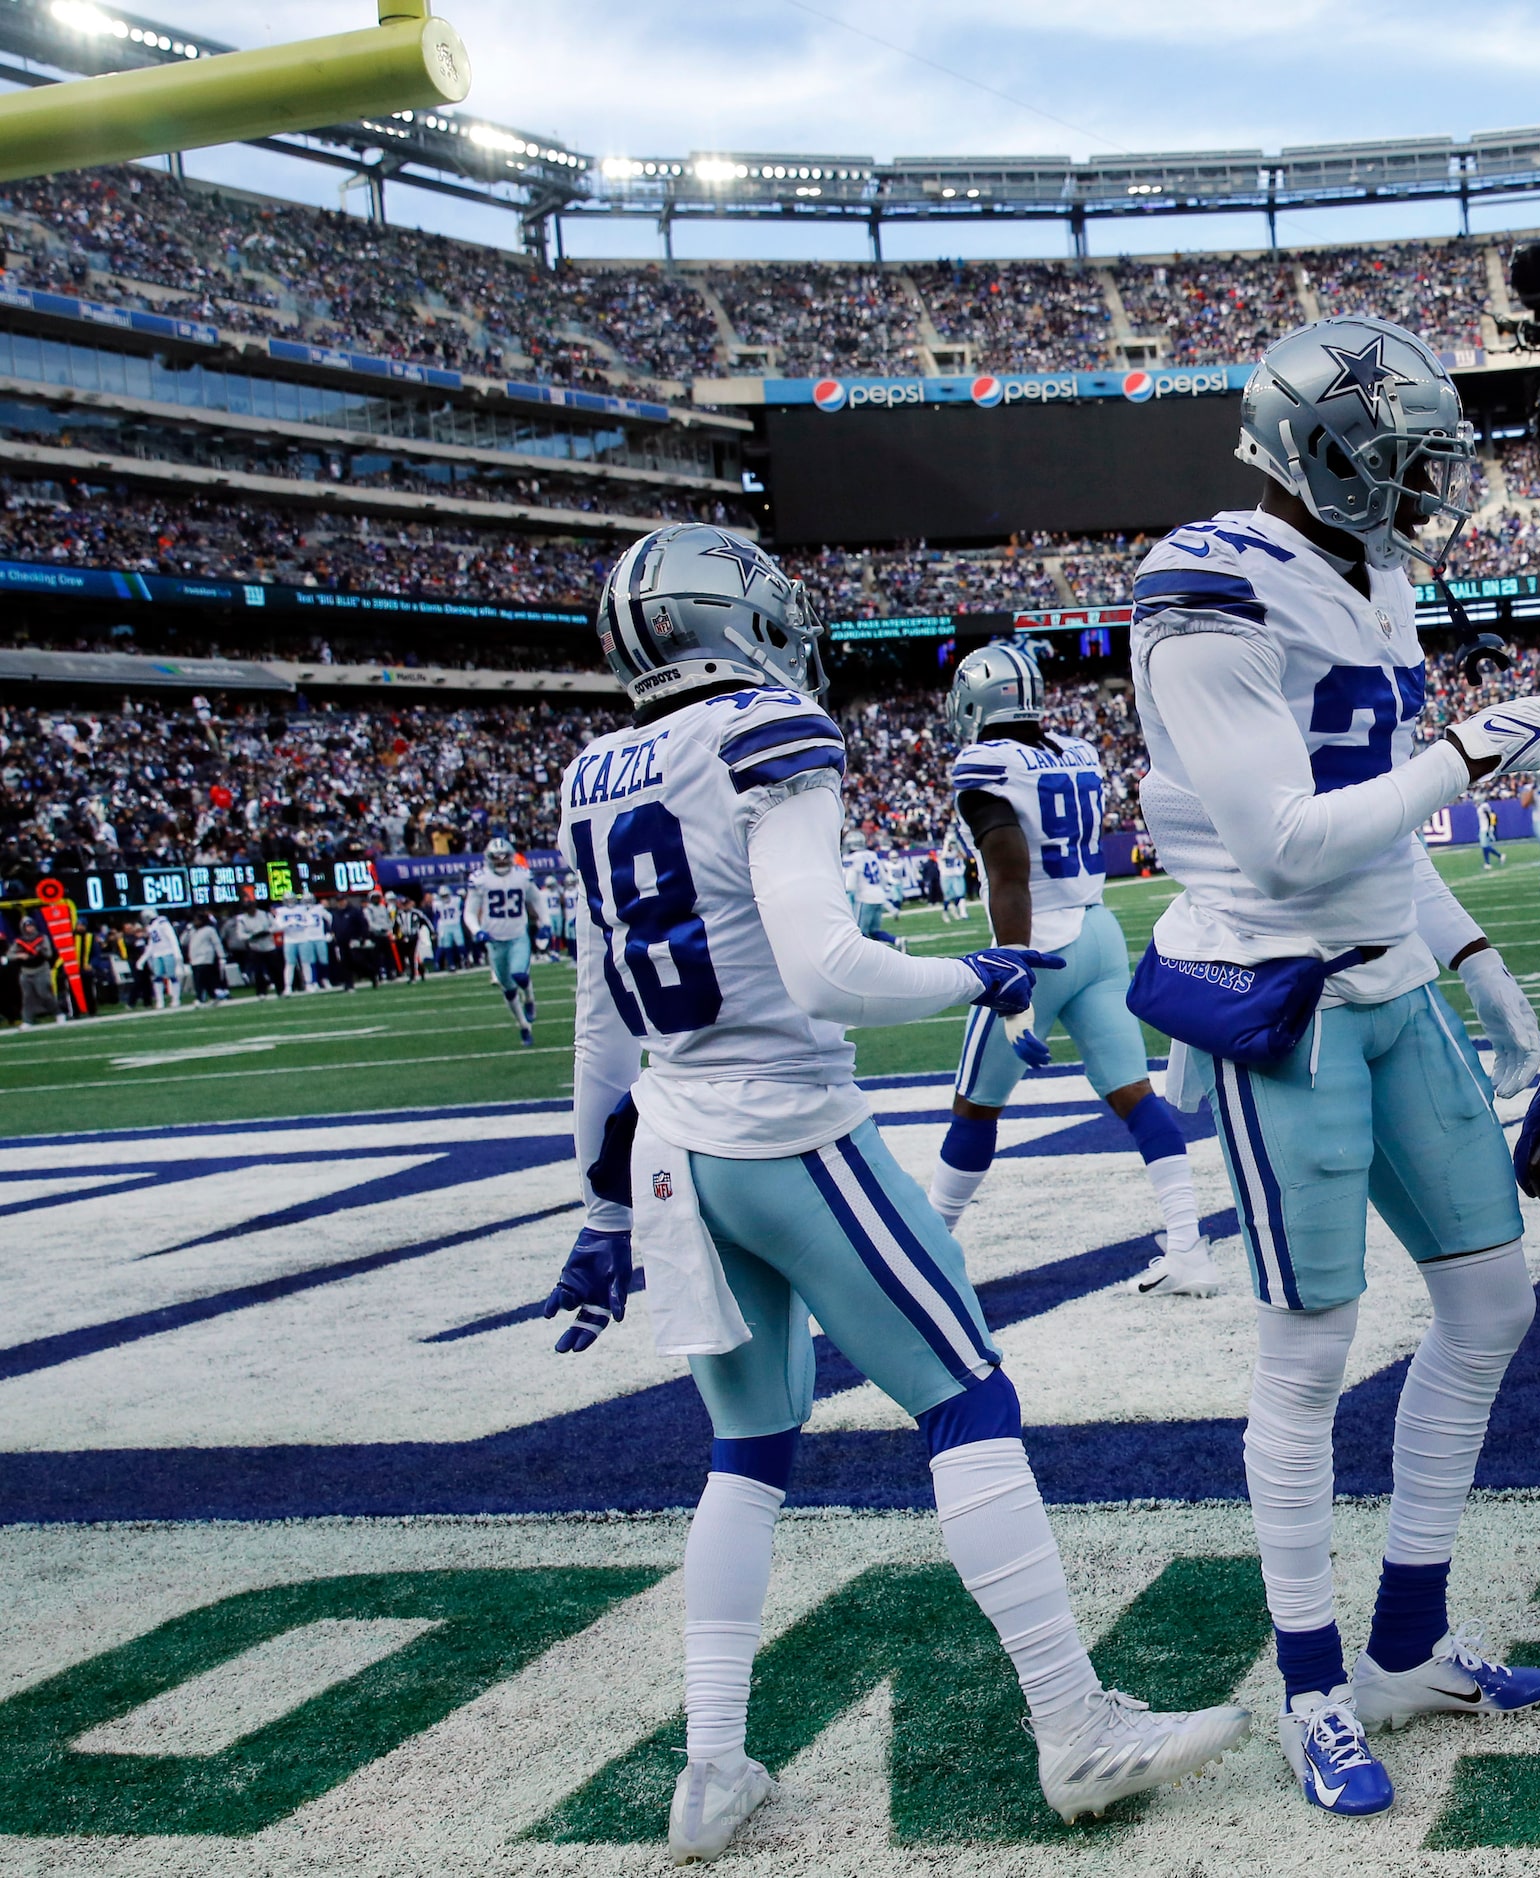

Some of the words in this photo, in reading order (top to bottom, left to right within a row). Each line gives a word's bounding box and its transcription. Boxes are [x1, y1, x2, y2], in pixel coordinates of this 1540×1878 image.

[848, 380, 925, 408] pepsi
[1004, 376, 1078, 403] pepsi
[1155, 368, 1228, 397] pepsi
[634, 668, 681, 695] COWBOYS
[570, 730, 670, 808] KAZEE
[1037, 771, 1106, 879] 90
[142, 875, 184, 904] 6:40
[272, 869, 292, 893] 25
[488, 889, 523, 918] 23
[571, 801, 724, 1036] 18
